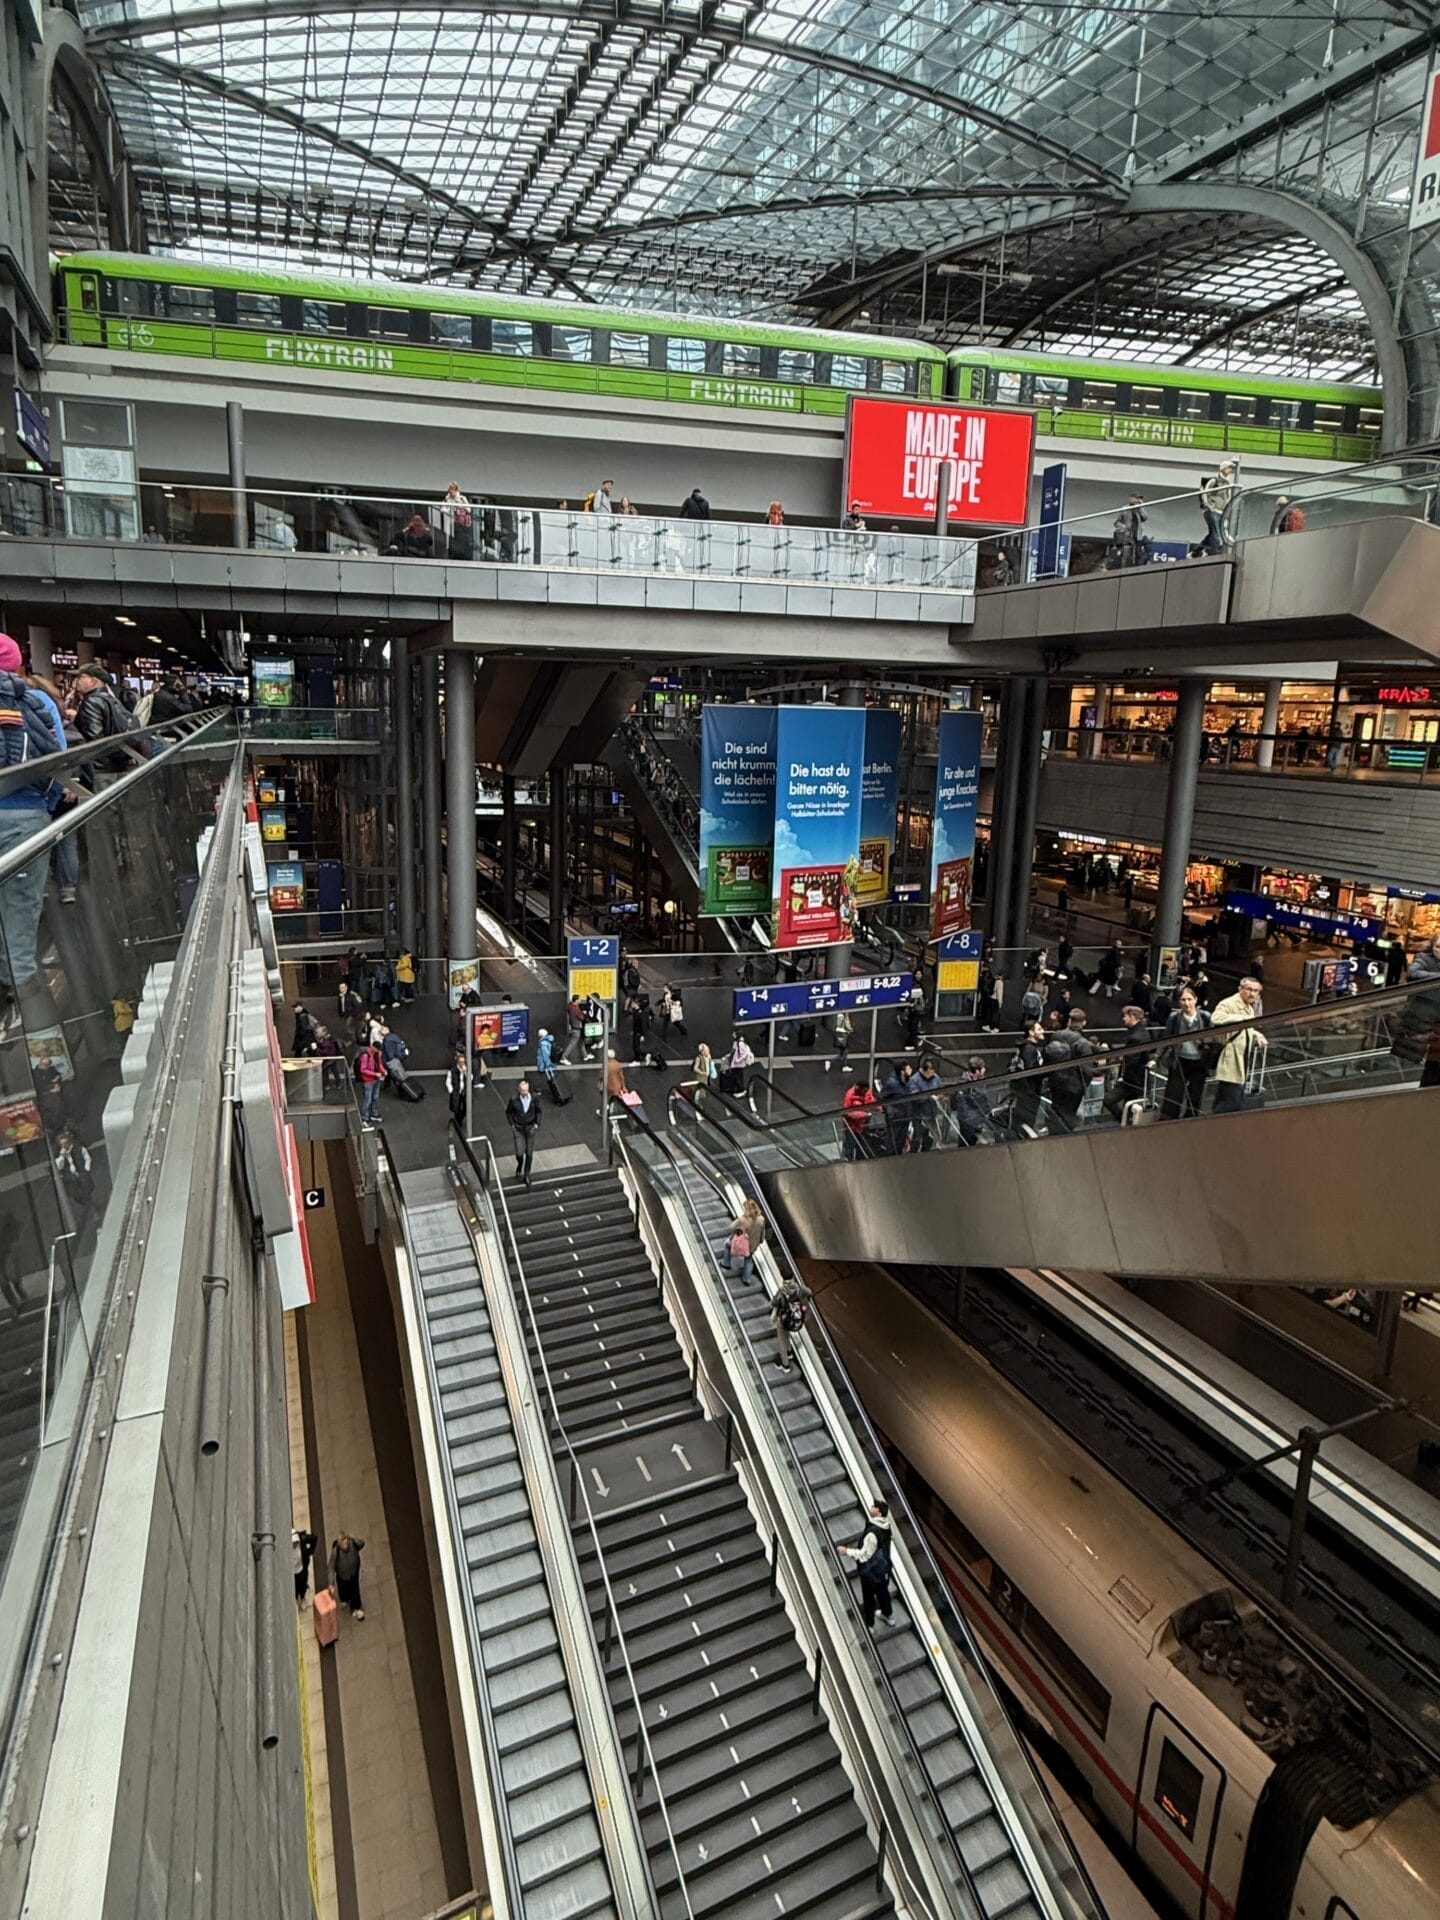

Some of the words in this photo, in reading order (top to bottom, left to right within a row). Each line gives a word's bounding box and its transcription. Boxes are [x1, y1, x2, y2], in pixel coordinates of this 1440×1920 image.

[266, 339, 393, 369] FLIXTRAIN
[690, 380, 795, 407] FLIXTRAIN
[905, 410, 962, 459] MADE
[964, 416, 986, 461] IN
[1101, 419, 1194, 443] FLIXTRAIN
[725, 742, 743, 754] Die
[745, 742, 767, 754] sind
[712, 757, 737, 769] nicht
[790, 763, 809, 777] Die
[811, 762, 834, 777] hast
[836, 762, 850, 777] du
[872, 762, 894, 774] Berlin.
[714, 773, 731, 785] die
[735, 773, 775, 785] lächeln!
[945, 766, 954, 779] Für
[954, 765, 964, 779] alte
[965, 764, 976, 778] und
[789, 781, 818, 795] bitter
[819, 782, 849, 798] nötig.
[939, 786, 955, 801] junge
[1353, 917, 1368, 928] 7-8
[583, 940, 609, 956] 1-2
[946, 933, 970, 950] 7-8
[1349, 956, 1359, 972] 5
[1367, 961, 1379, 977] 6
[751, 989, 769, 1002] 1-4
[306, 1191, 319, 1206] C
